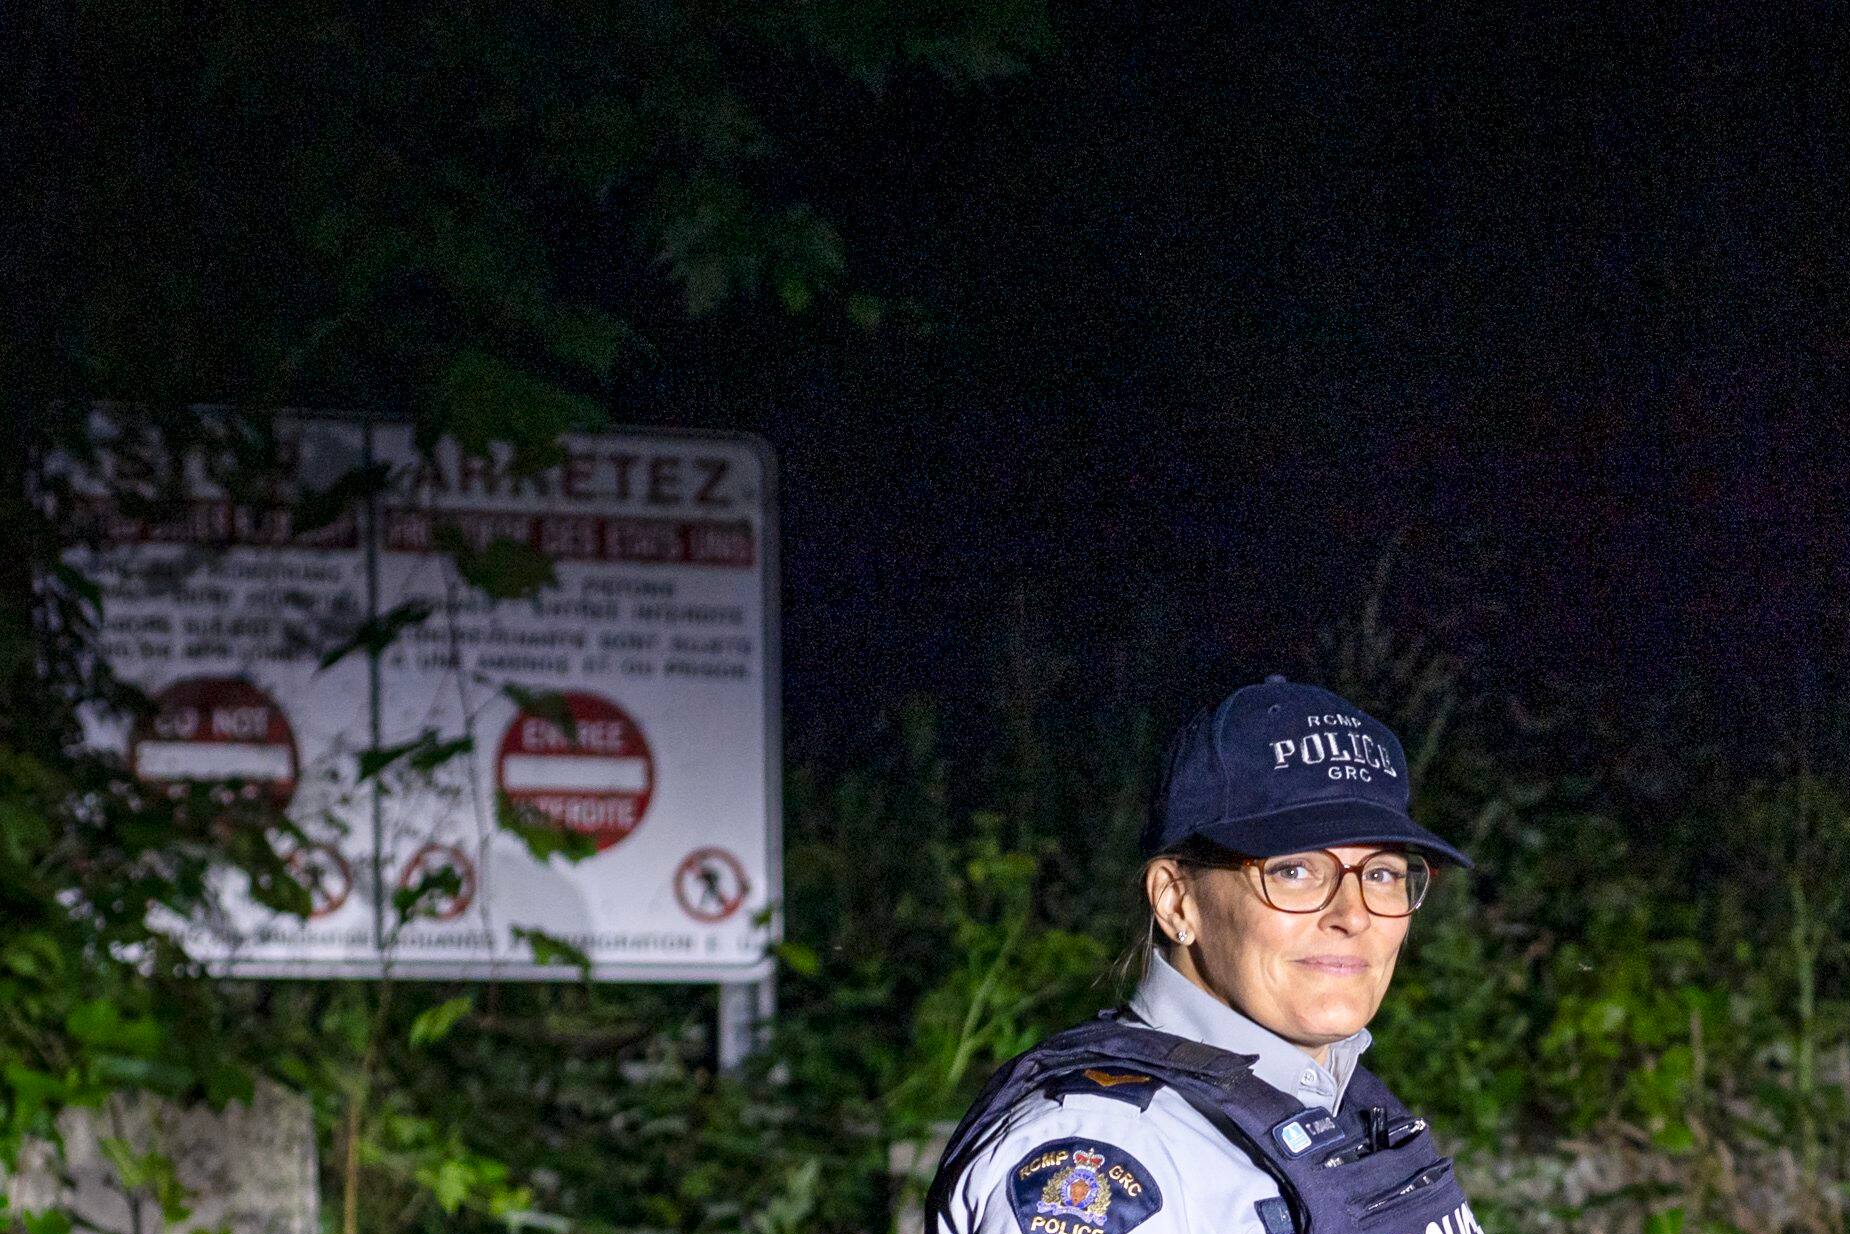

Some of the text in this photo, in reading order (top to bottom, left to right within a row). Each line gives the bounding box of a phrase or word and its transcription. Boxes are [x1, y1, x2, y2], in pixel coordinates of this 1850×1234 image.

[1307, 714, 1362, 728] RCMP
[1269, 732, 1397, 777] POLICE
[1328, 766, 1371, 782] GRC
[1018, 1151, 1069, 1180] RCMP
[1108, 1165, 1142, 1197] GRC
